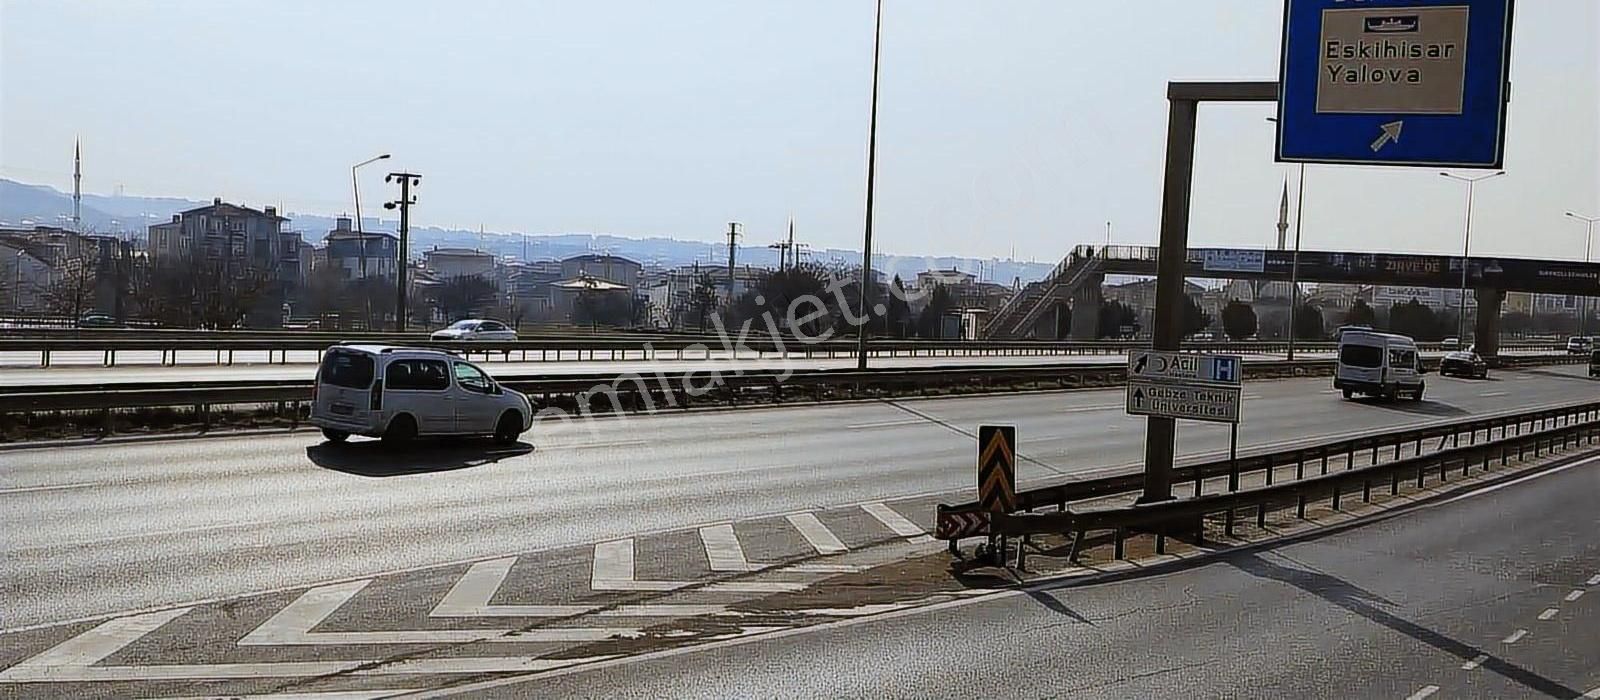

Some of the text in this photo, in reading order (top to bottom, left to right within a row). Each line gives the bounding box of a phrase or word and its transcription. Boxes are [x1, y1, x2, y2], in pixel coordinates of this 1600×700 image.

[1326, 40, 1455, 59] Eskihisar
[1327, 64, 1421, 83] Yalova
[1148, 387, 1234, 404] Gebze Teknik
